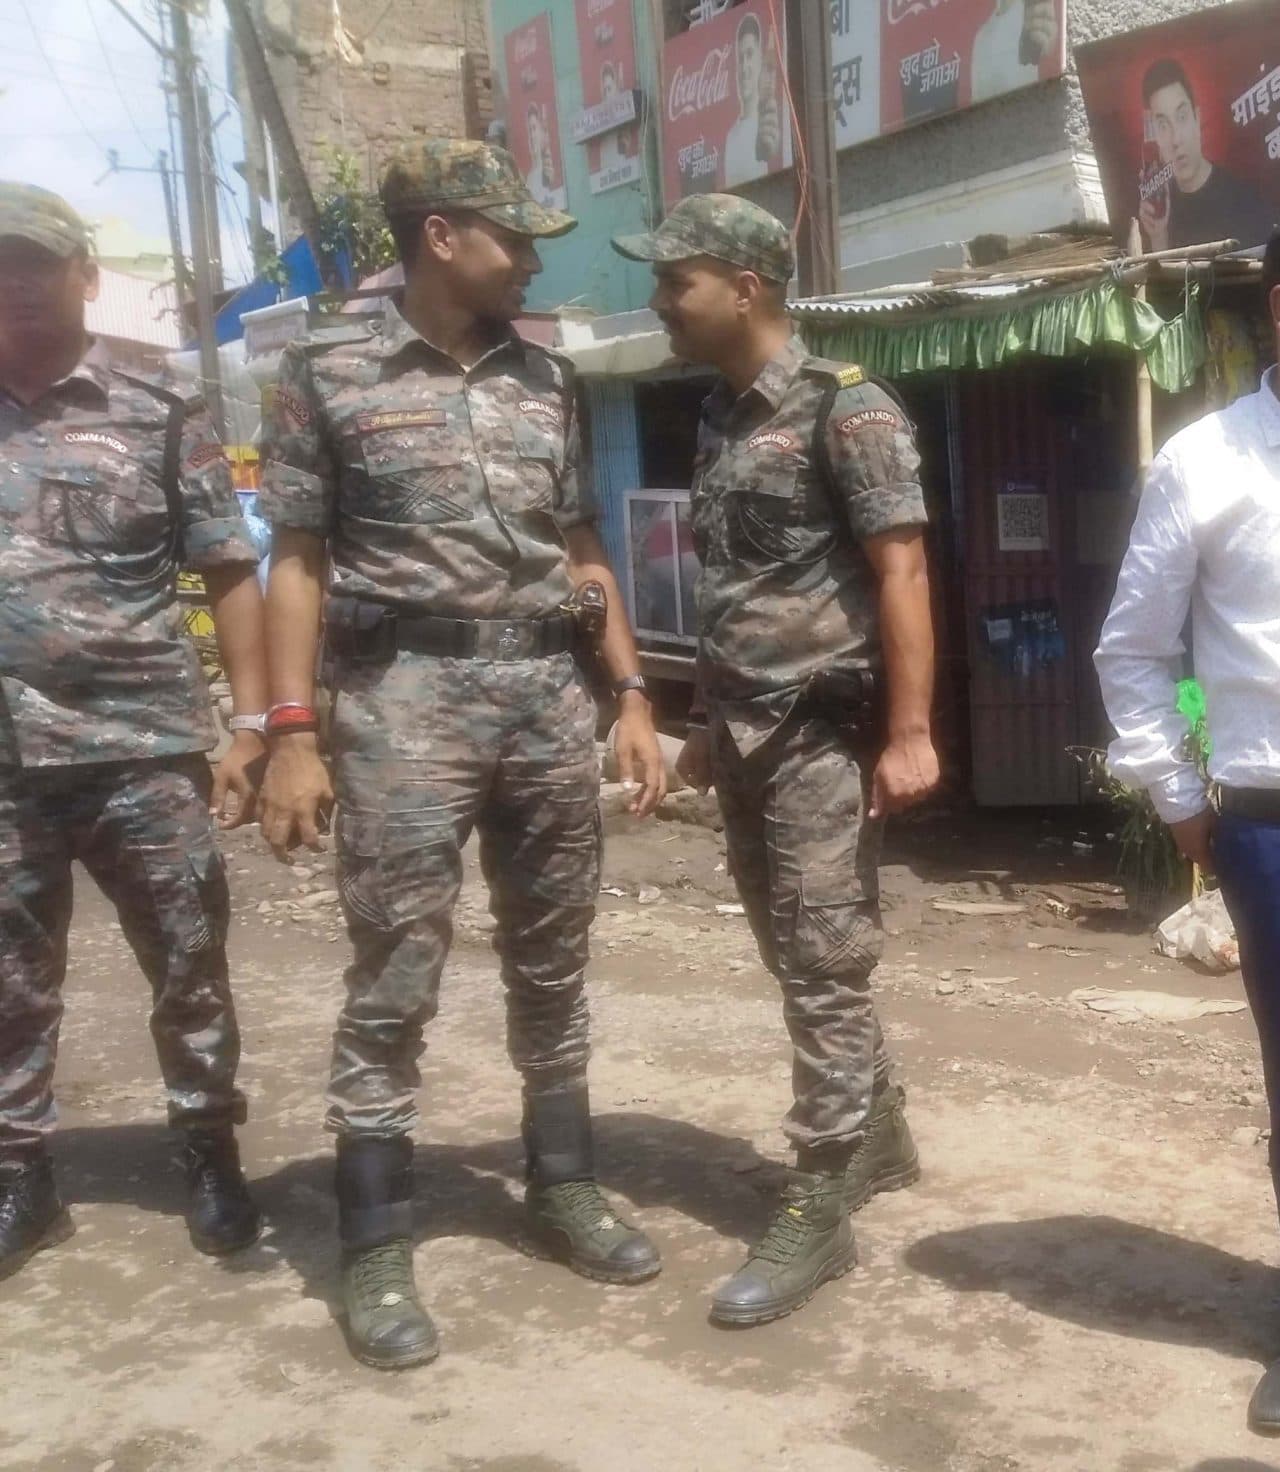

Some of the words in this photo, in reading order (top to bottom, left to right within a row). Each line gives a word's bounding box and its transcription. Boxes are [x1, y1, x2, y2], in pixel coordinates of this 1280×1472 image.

[900, 51, 920, 86] खुद
[922, 38, 941, 70] को
[919, 52, 961, 93] जगाओ
[842, 410, 895, 432] COMMANDO
[64, 432, 128, 454] COMMANDO
